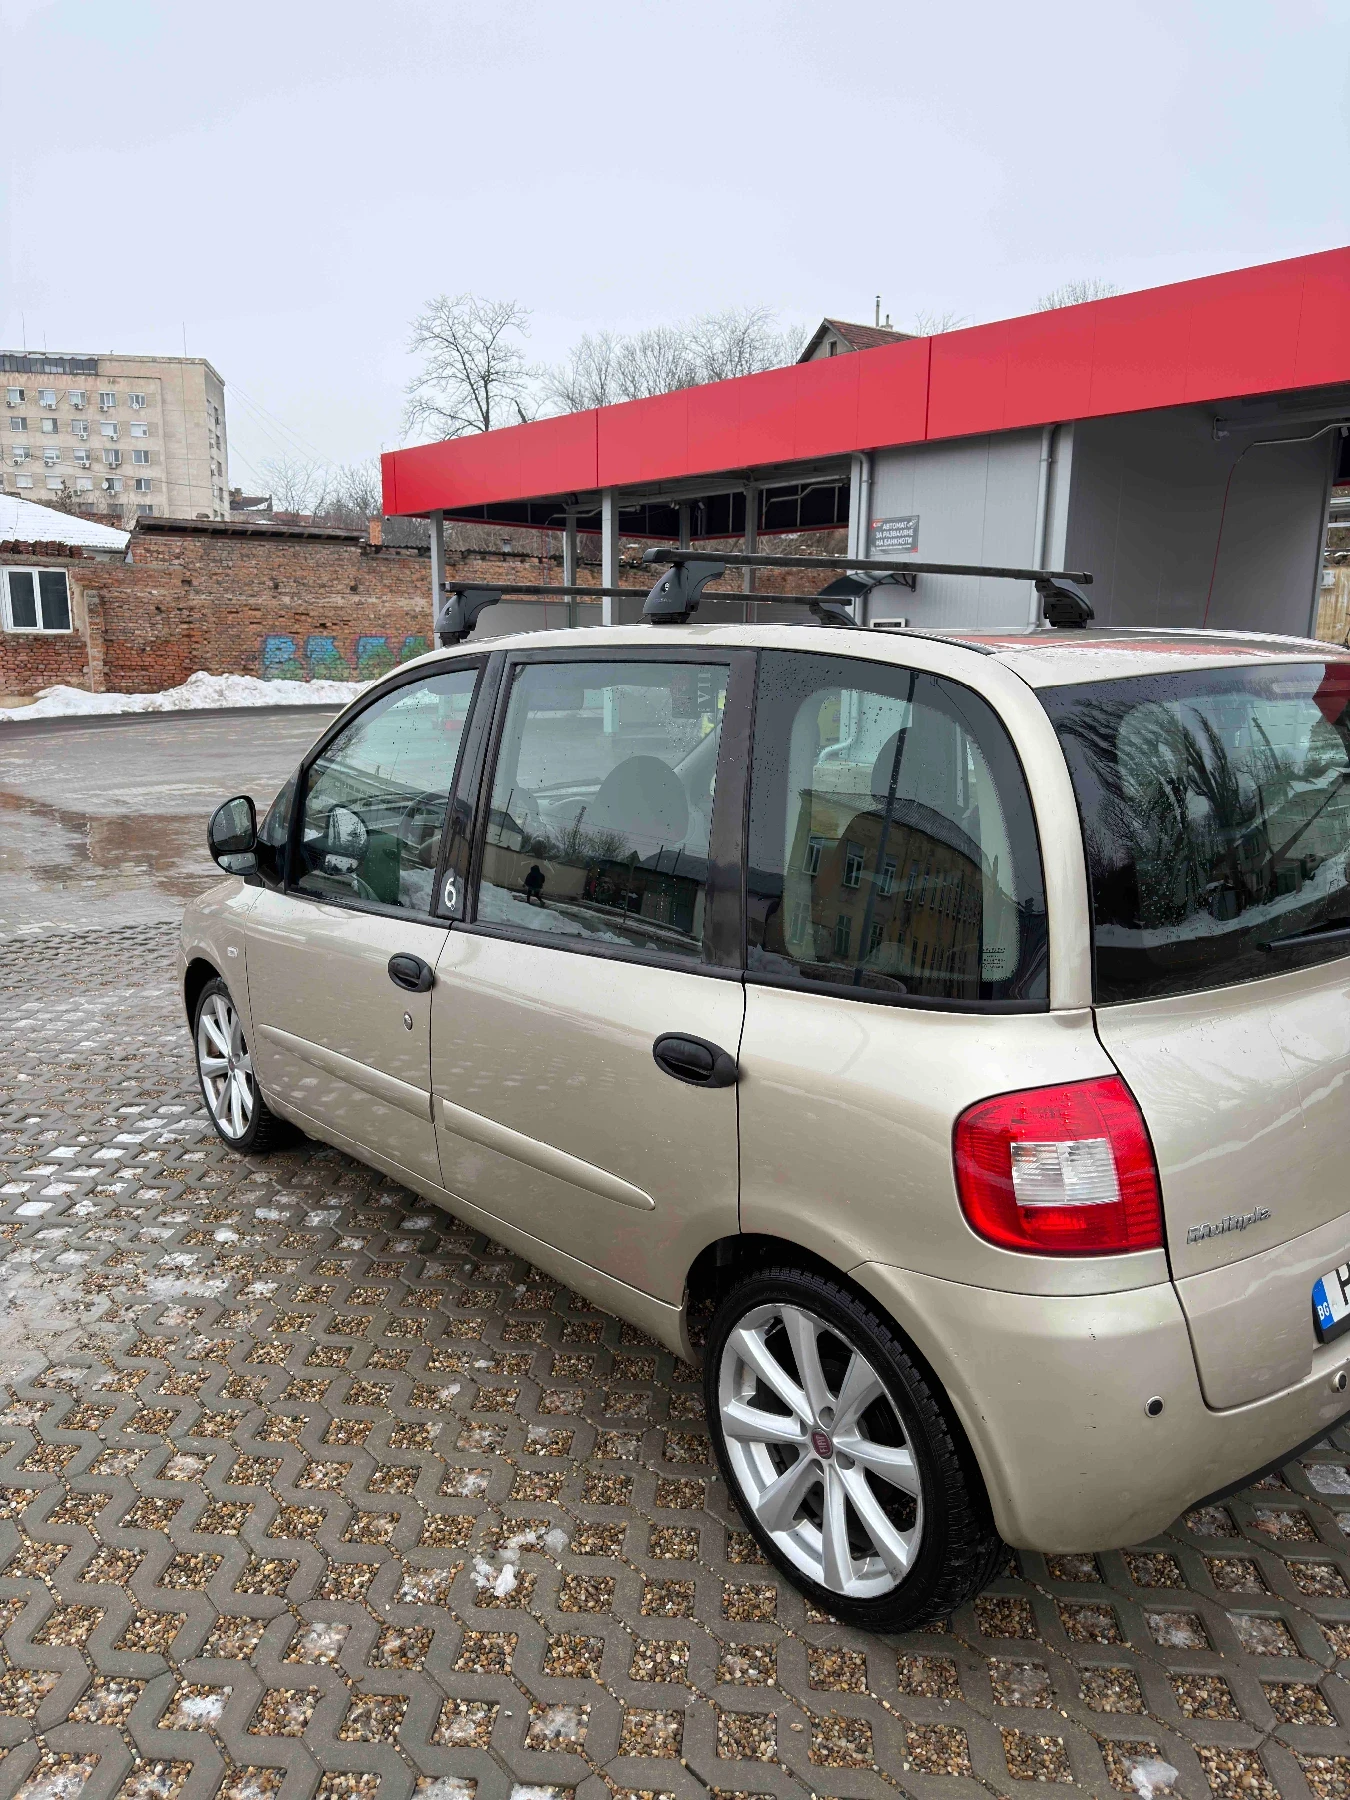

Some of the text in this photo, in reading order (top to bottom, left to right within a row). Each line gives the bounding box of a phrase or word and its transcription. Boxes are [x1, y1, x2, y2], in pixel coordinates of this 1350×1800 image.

[882, 521, 907, 530] АВТОМАТ
[883, 529, 913, 538] РАЗВАЛЯНЕ
[884, 537, 912, 545] БАНКНОТИ
[445, 877, 456, 910] 6
[1187, 1205, 1272, 1244] Multipla
[1317, 1301, 1330, 1320] BG
[816, 1435, 828, 1453] FIAT
